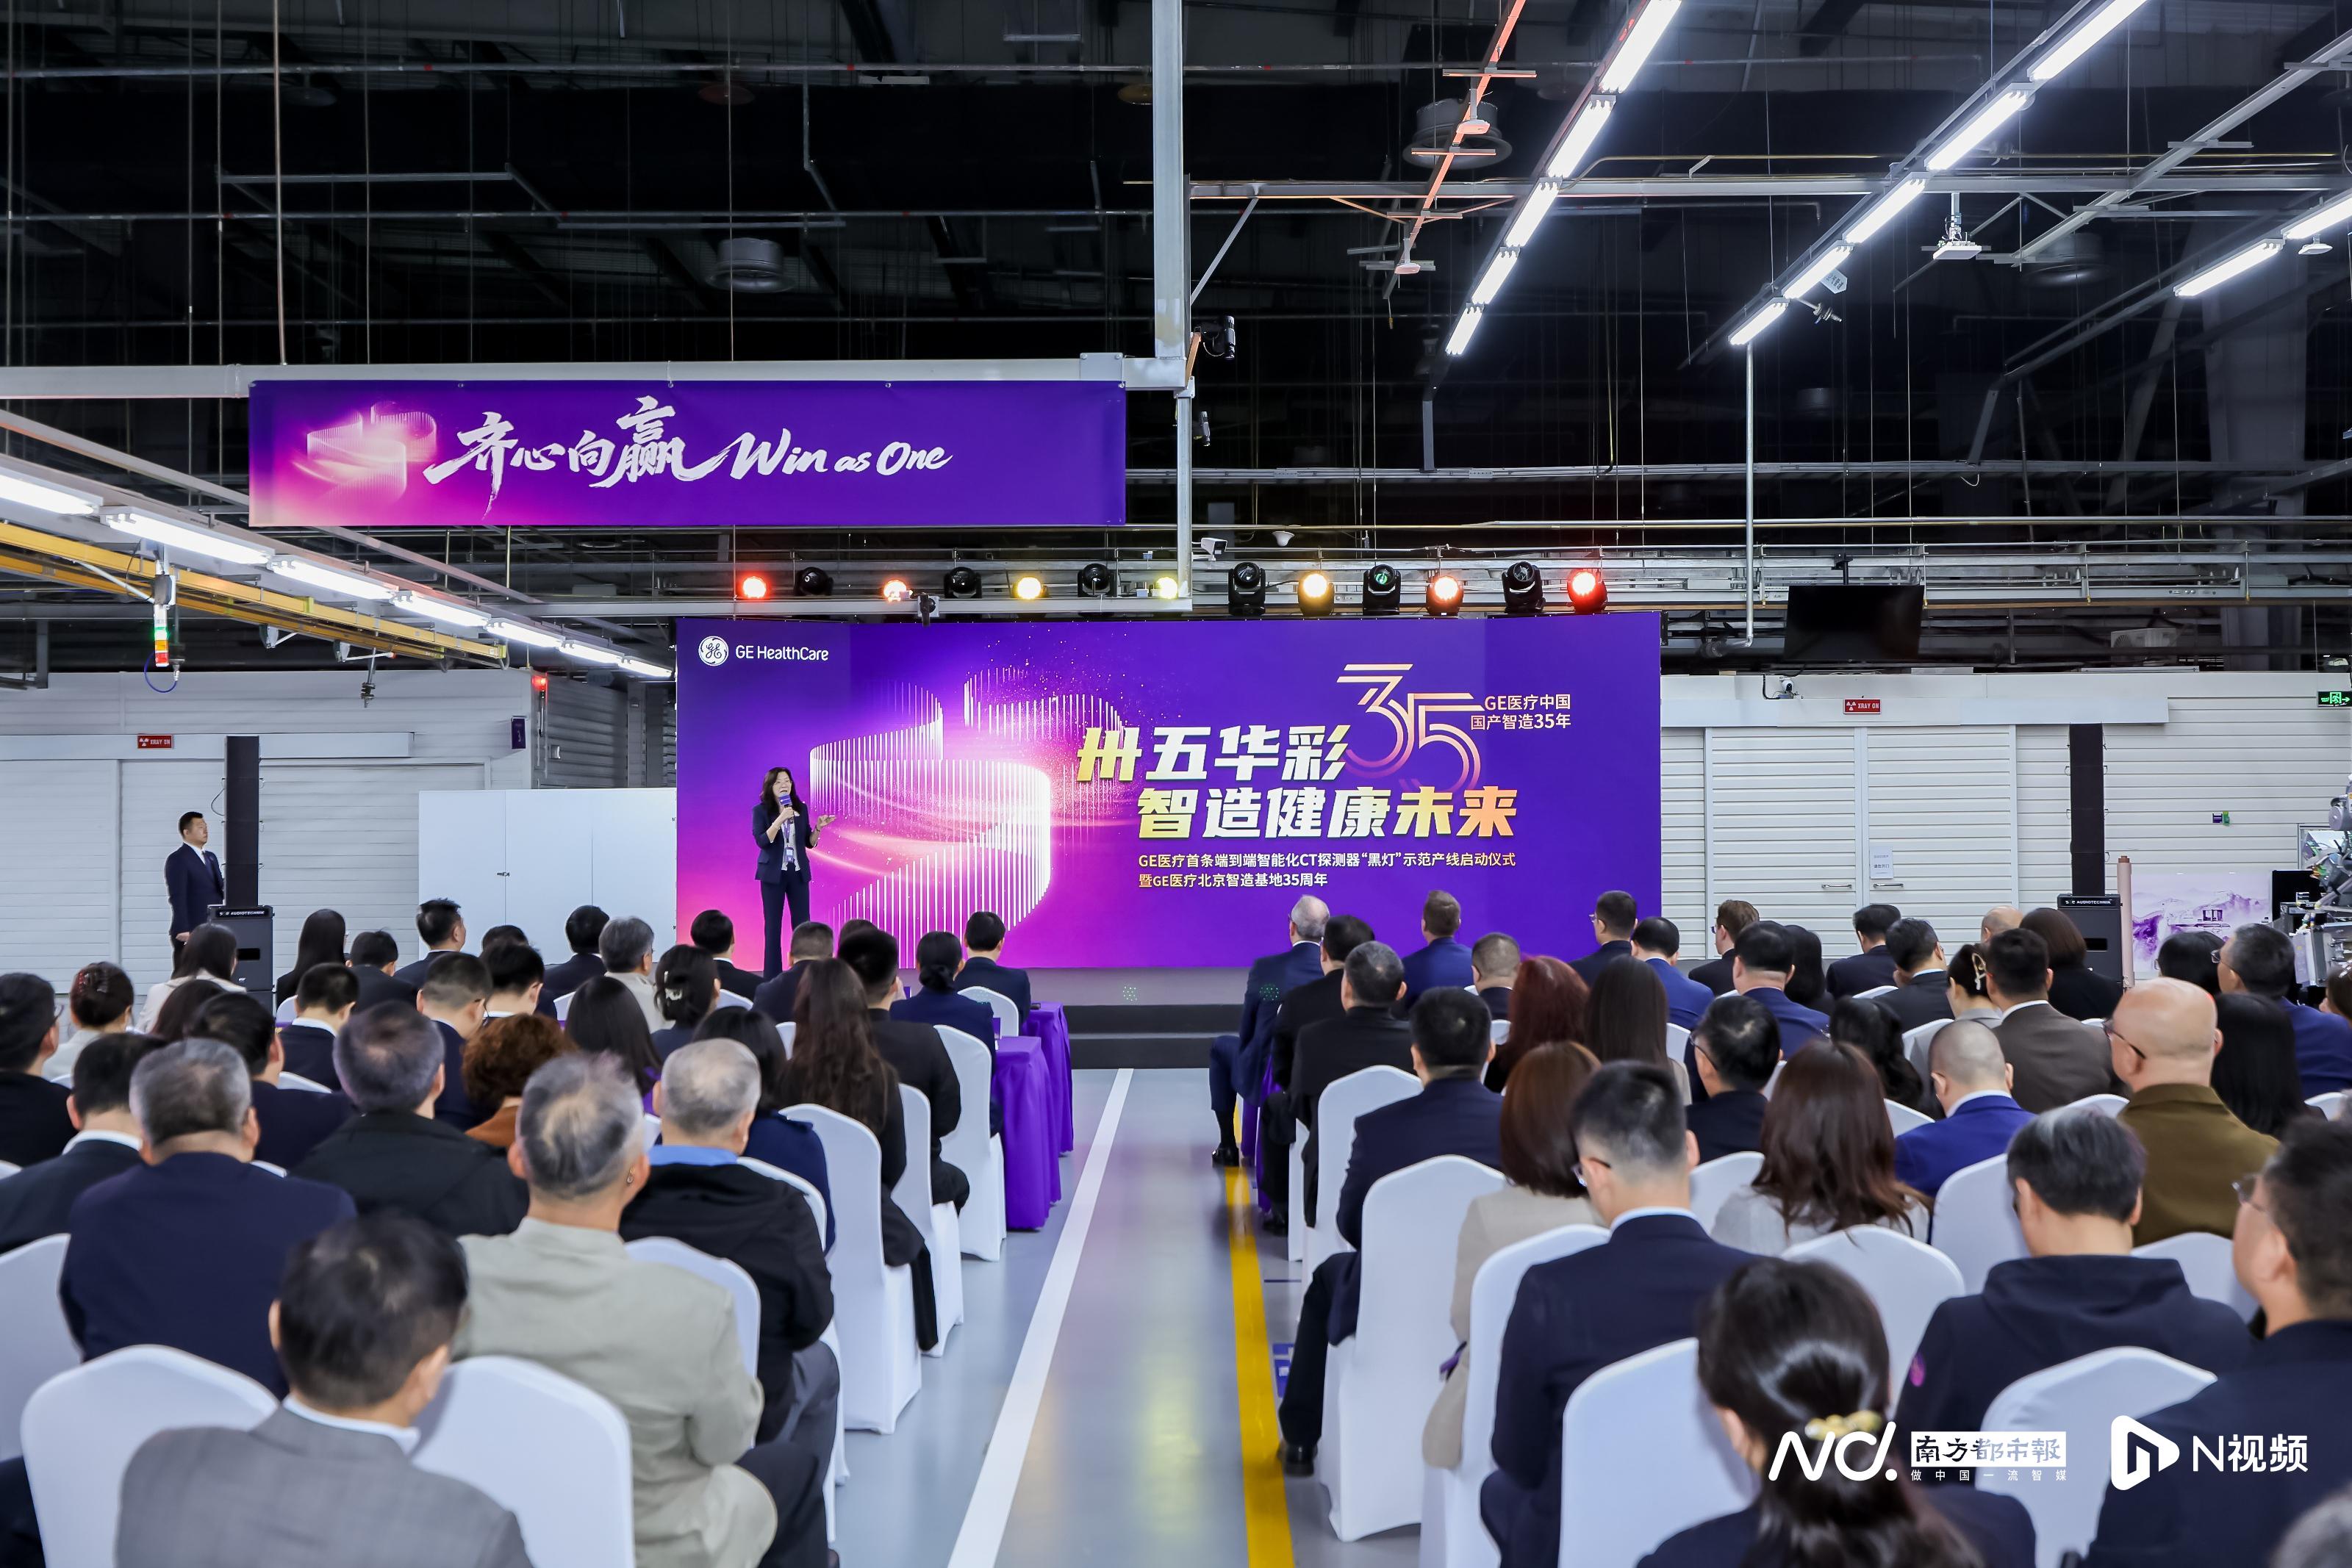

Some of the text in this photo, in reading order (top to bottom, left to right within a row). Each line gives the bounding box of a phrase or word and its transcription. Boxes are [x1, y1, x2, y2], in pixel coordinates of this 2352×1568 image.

[423, 395, 953, 520] 齐心向赢 Win as One
[736, 644, 829, 661] GE HealthCare
[1484, 694, 1571, 711] GE医疗中国
[1471, 713, 1571, 730] 国产智造35年
[1076, 724, 1351, 781] 卅五华彩
[1137, 786, 1518, 838] 智造健康未来
[1139, 873, 1328, 888] 暨GE医疗北京智造基地35周年
